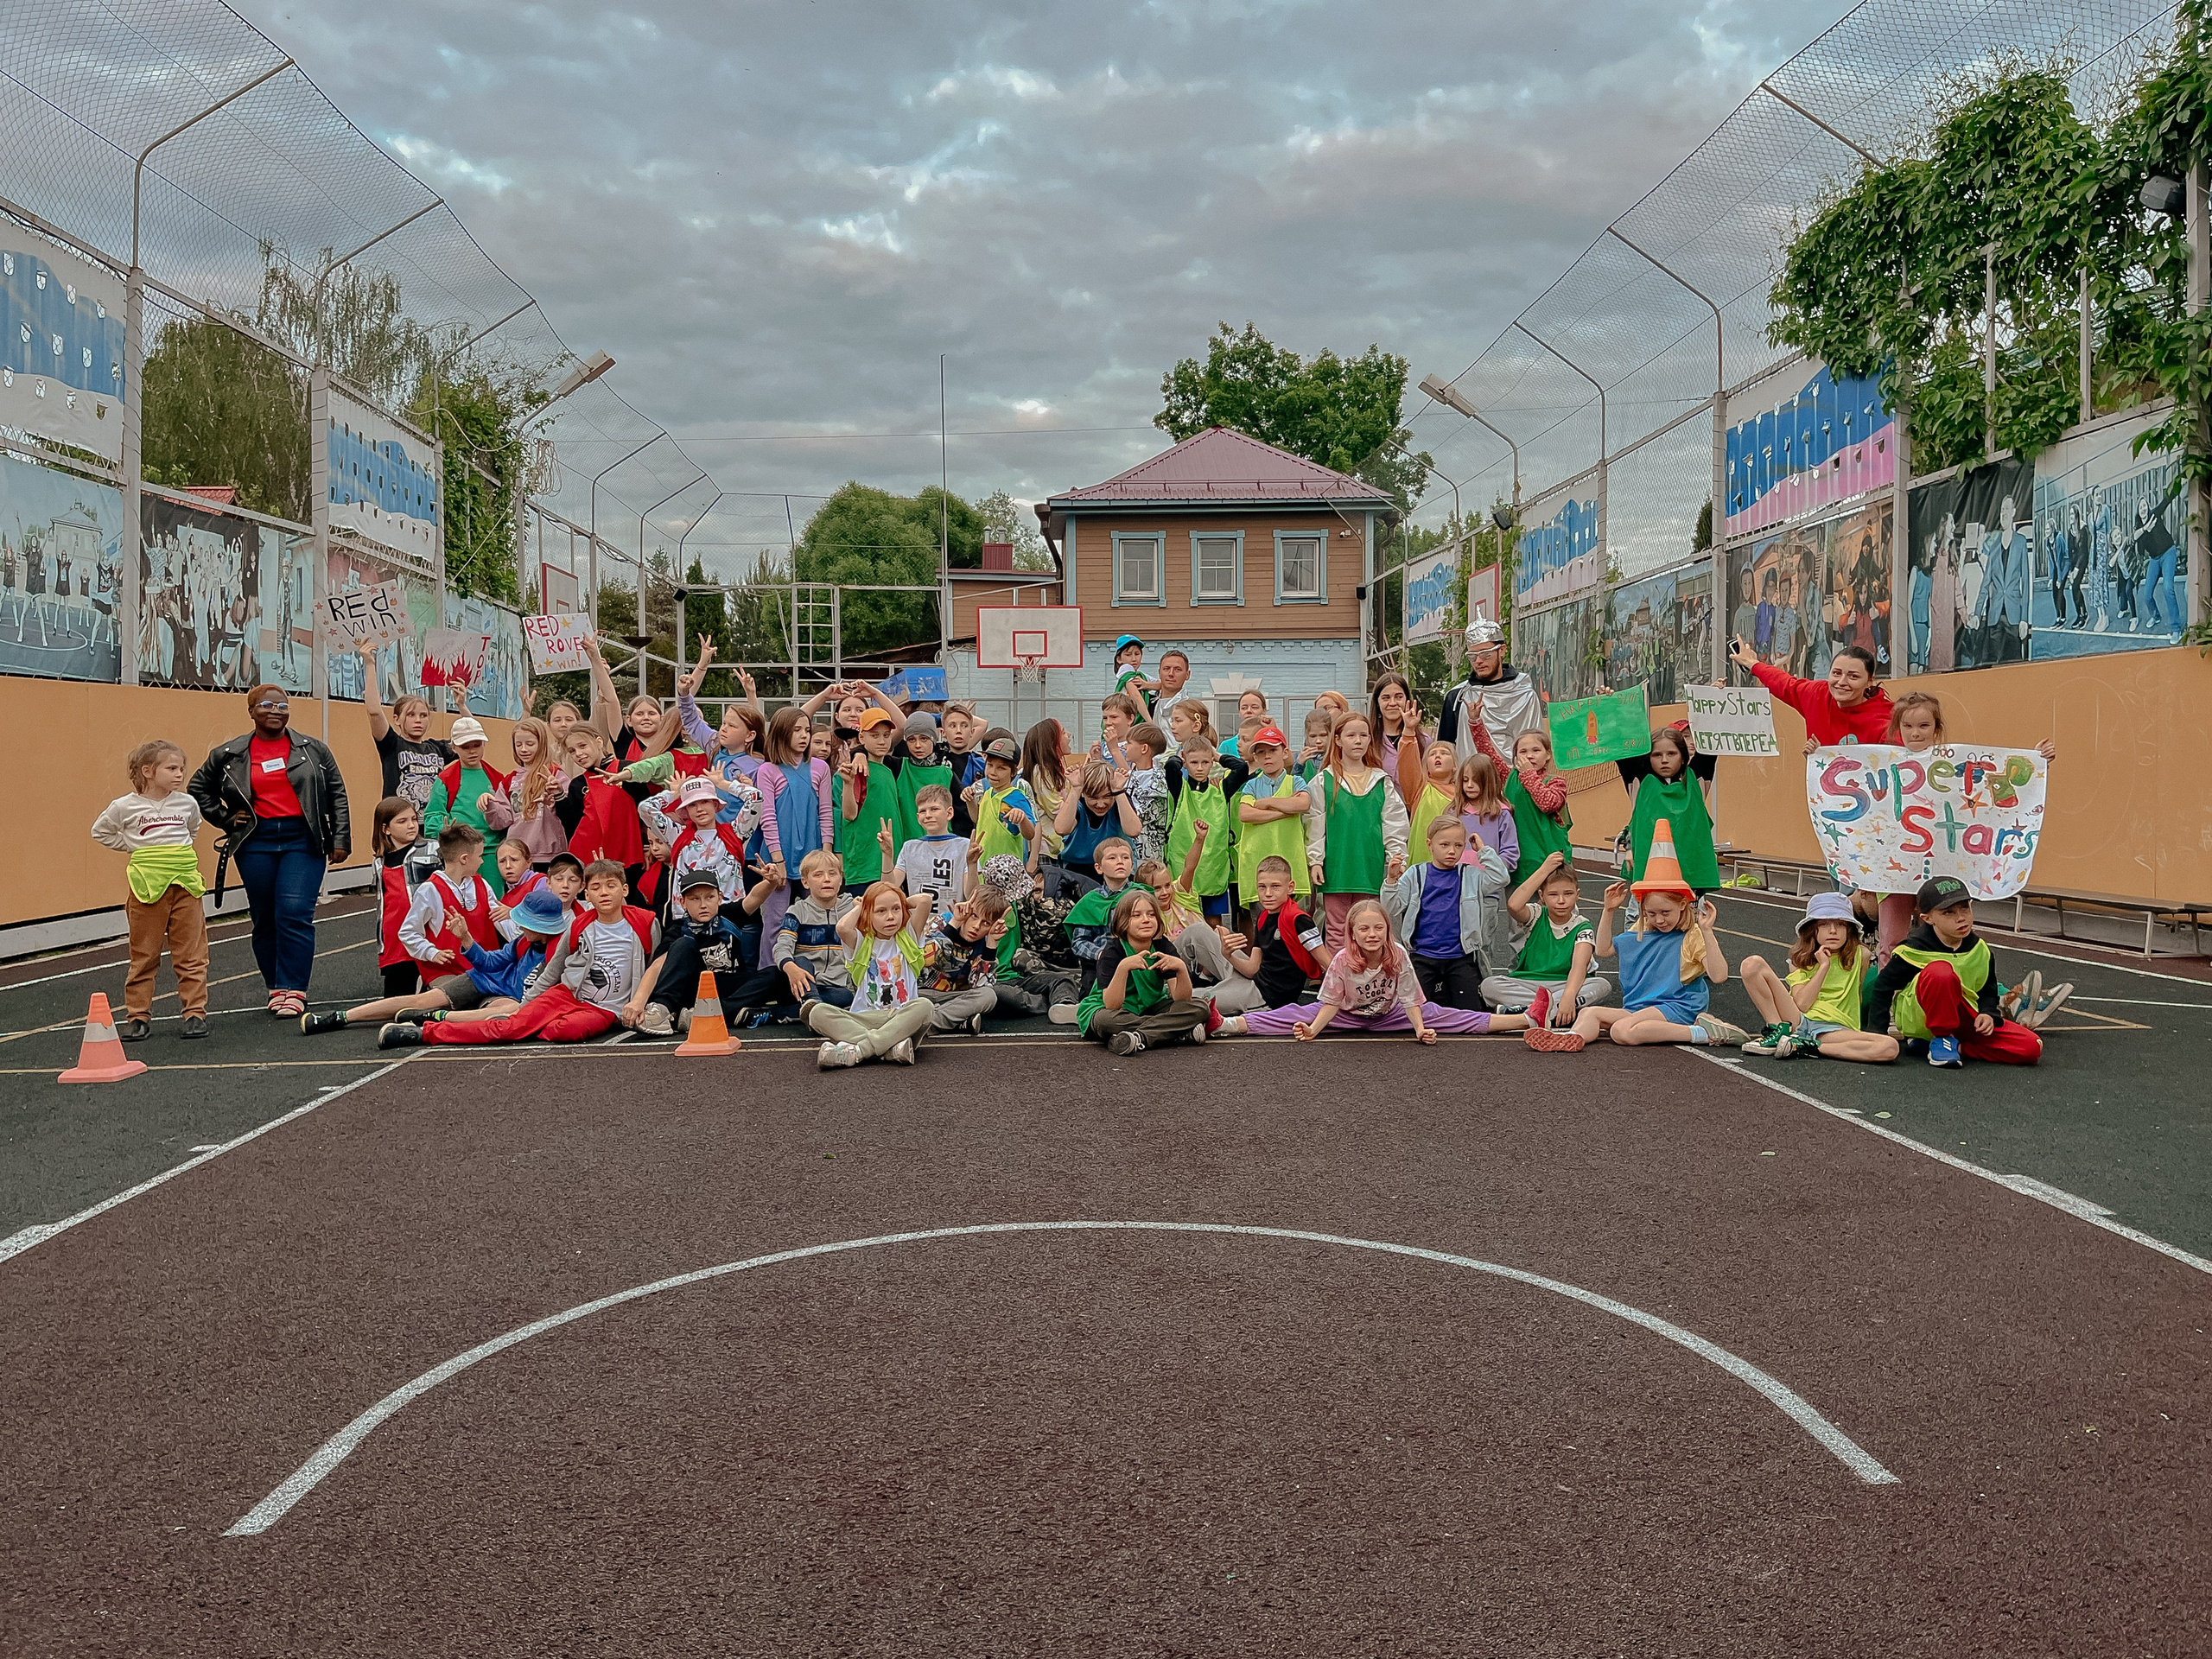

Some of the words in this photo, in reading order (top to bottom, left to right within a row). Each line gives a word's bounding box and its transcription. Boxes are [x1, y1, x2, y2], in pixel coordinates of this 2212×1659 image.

[524, 616, 559, 639] RED
[546, 637, 583, 654] ROVE
[1559, 697, 1602, 720] HAPPY
[137, 815, 183, 827] Abercrombie
[1900, 801, 2039, 859] Stars
[594, 956, 616, 970] ERIOR
[613, 970, 622, 994] TEAM
[1365, 988, 1386, 999] COOL
